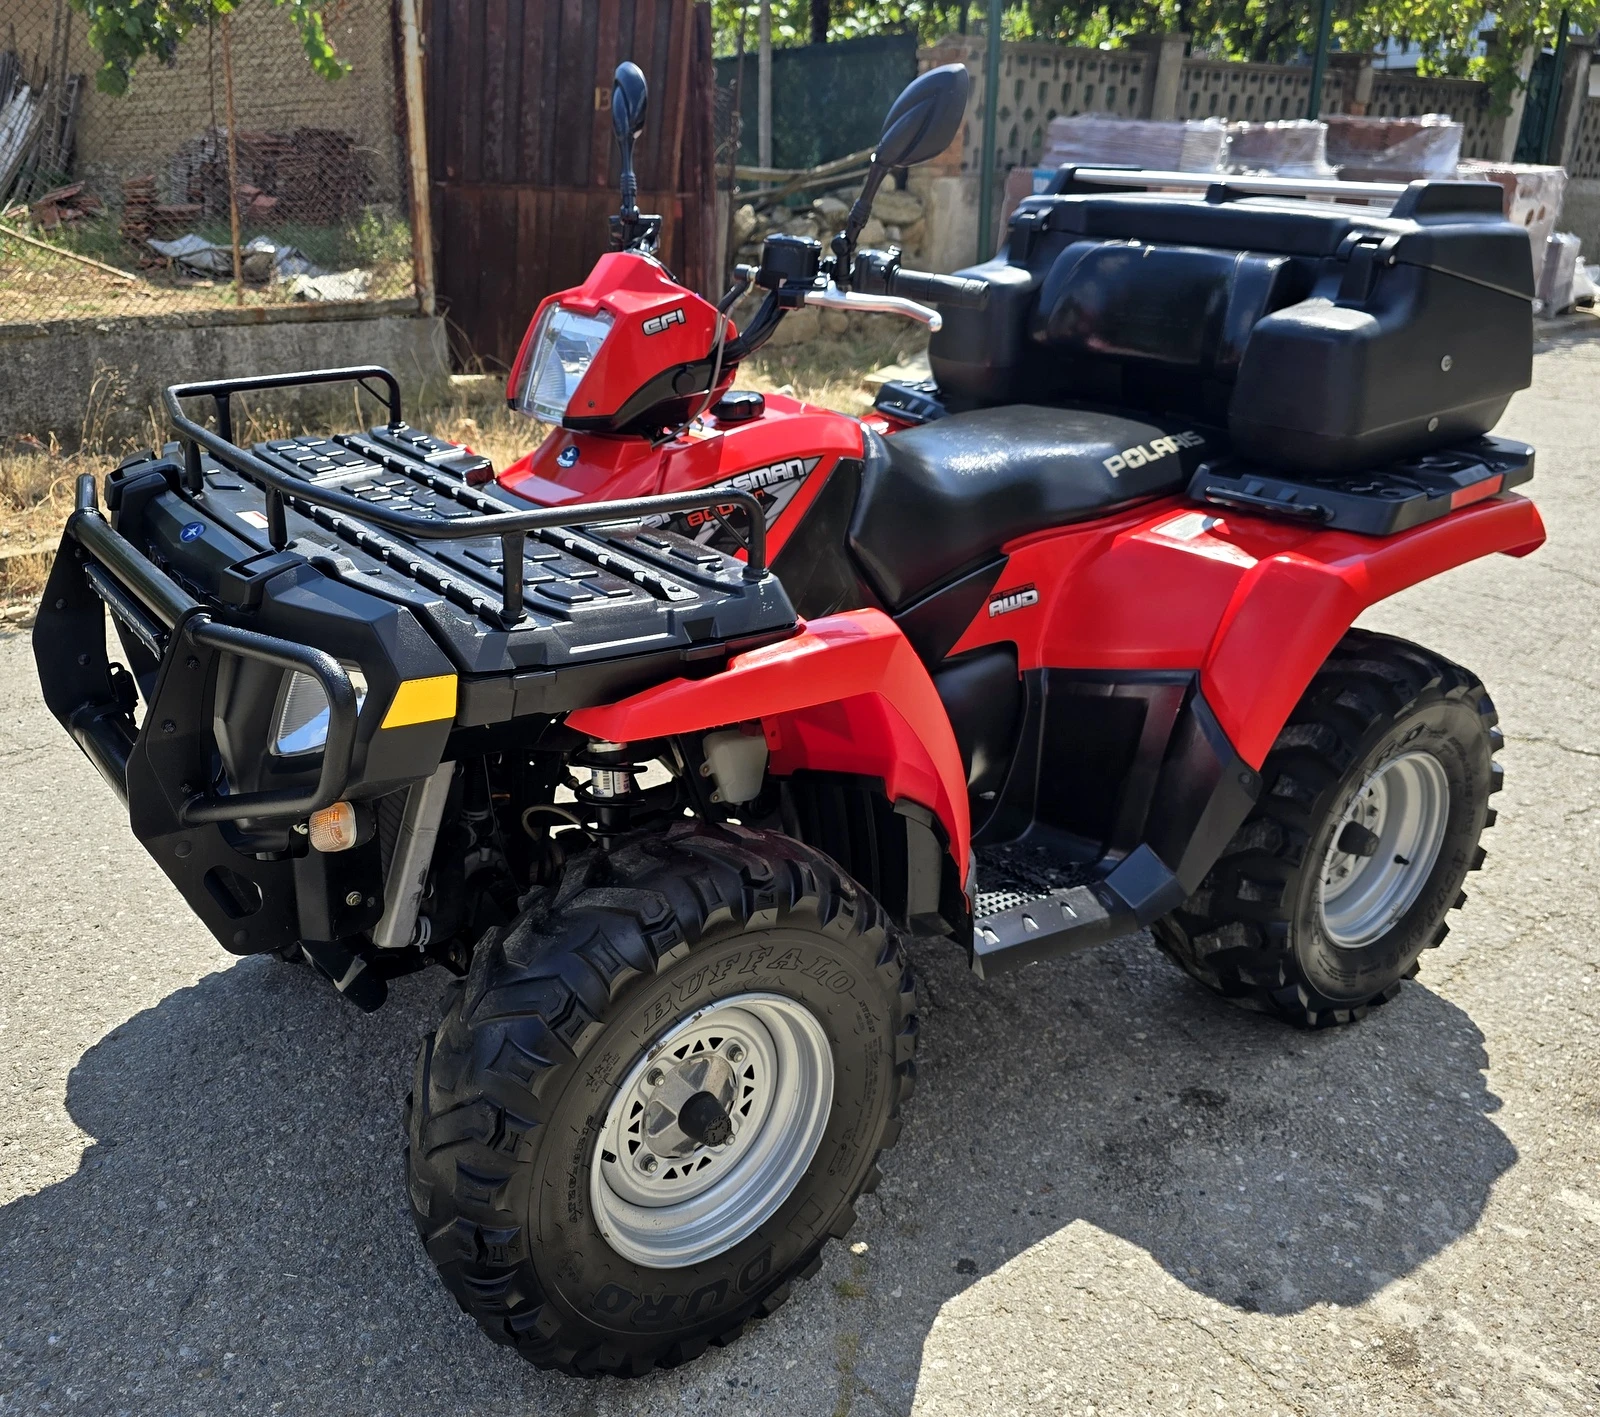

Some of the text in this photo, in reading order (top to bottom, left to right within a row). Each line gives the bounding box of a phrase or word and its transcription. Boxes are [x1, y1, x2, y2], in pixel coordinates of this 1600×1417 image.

[642, 308, 685, 336] EFI
[1102, 431, 1205, 478] POLARIS
[989, 590, 1038, 617] AWD
[643, 946, 856, 1034] BUFFALO
[592, 1241, 774, 1325] DURO
